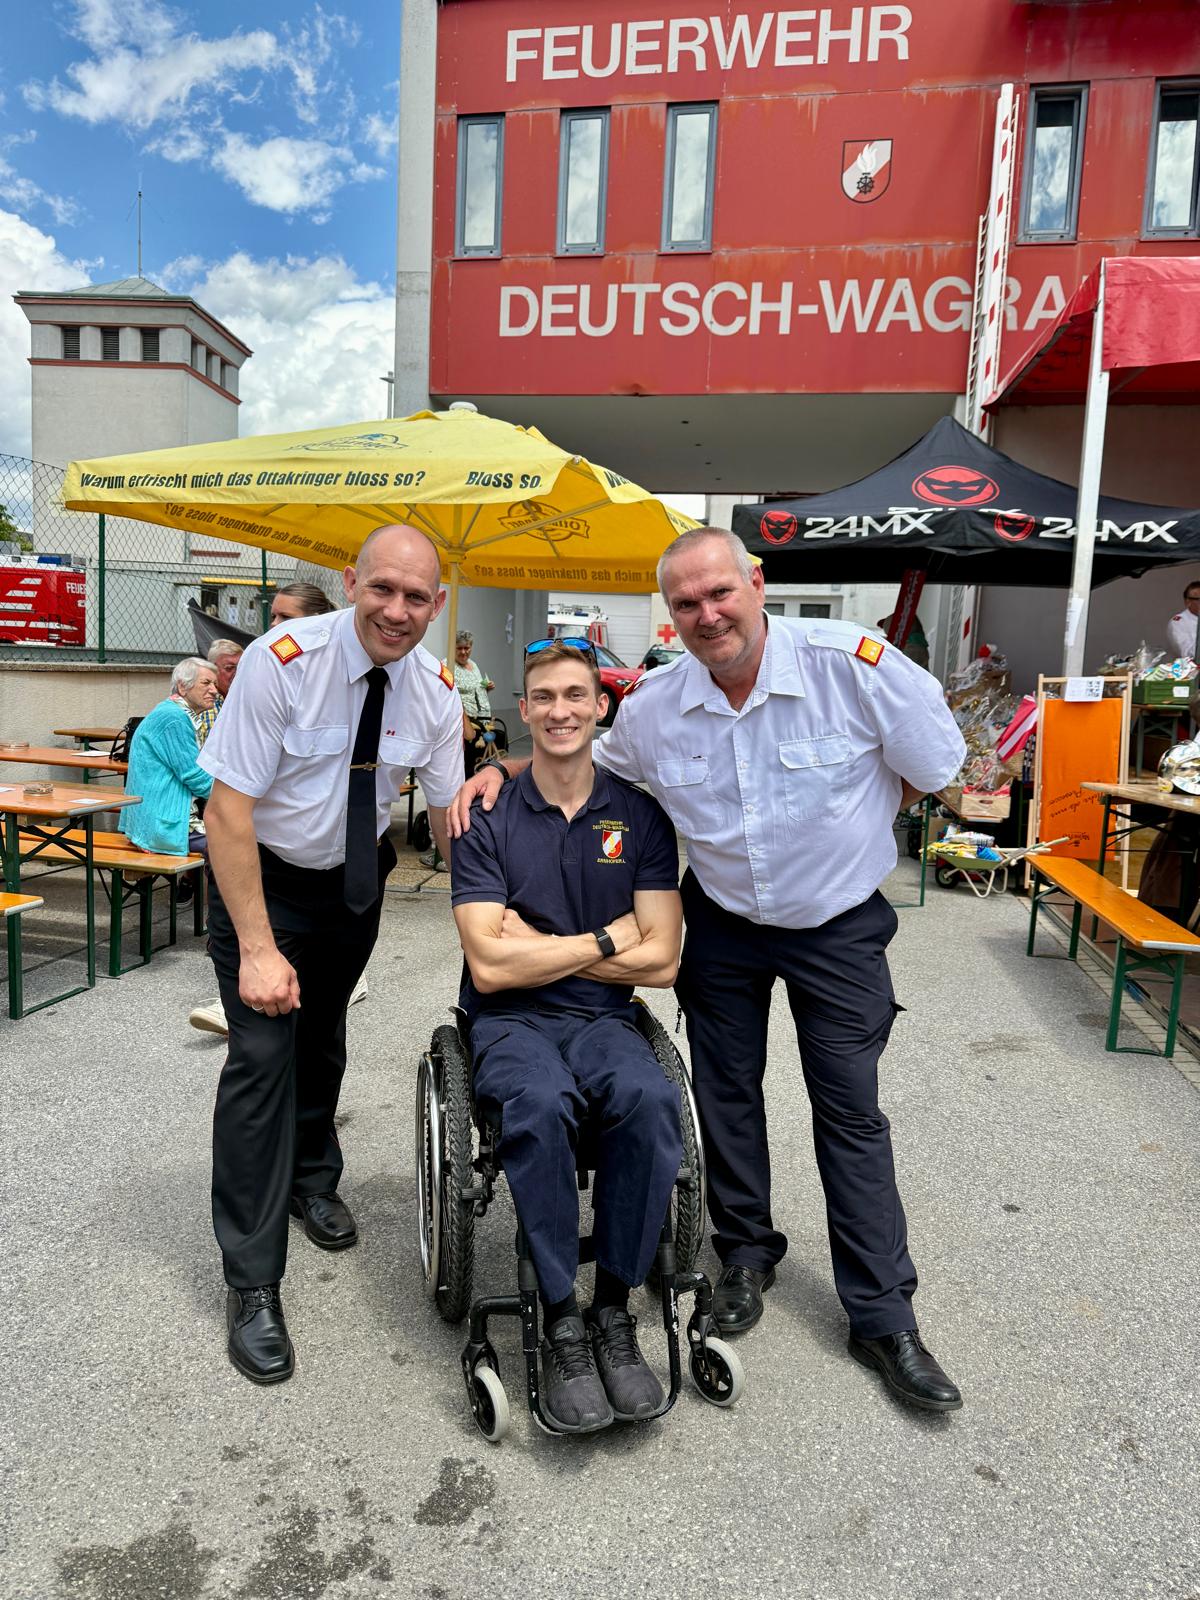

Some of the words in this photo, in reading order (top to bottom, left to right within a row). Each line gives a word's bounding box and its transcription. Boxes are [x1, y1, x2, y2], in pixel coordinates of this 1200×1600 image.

[505, 5, 912, 82] FEUERWEHR
[499, 275, 1086, 337] DEUTSCH-WAGRA
[80, 472, 125, 489] Warum
[128, 473, 188, 489] erfrischt
[190, 471, 223, 489] mich
[226, 471, 253, 487] das
[256, 470, 342, 487] Ottakringer
[344, 471, 389, 487] bloss
[393, 470, 426, 487] so?
[465, 471, 514, 490] Bloss
[803, 512, 935, 539] 24MX
